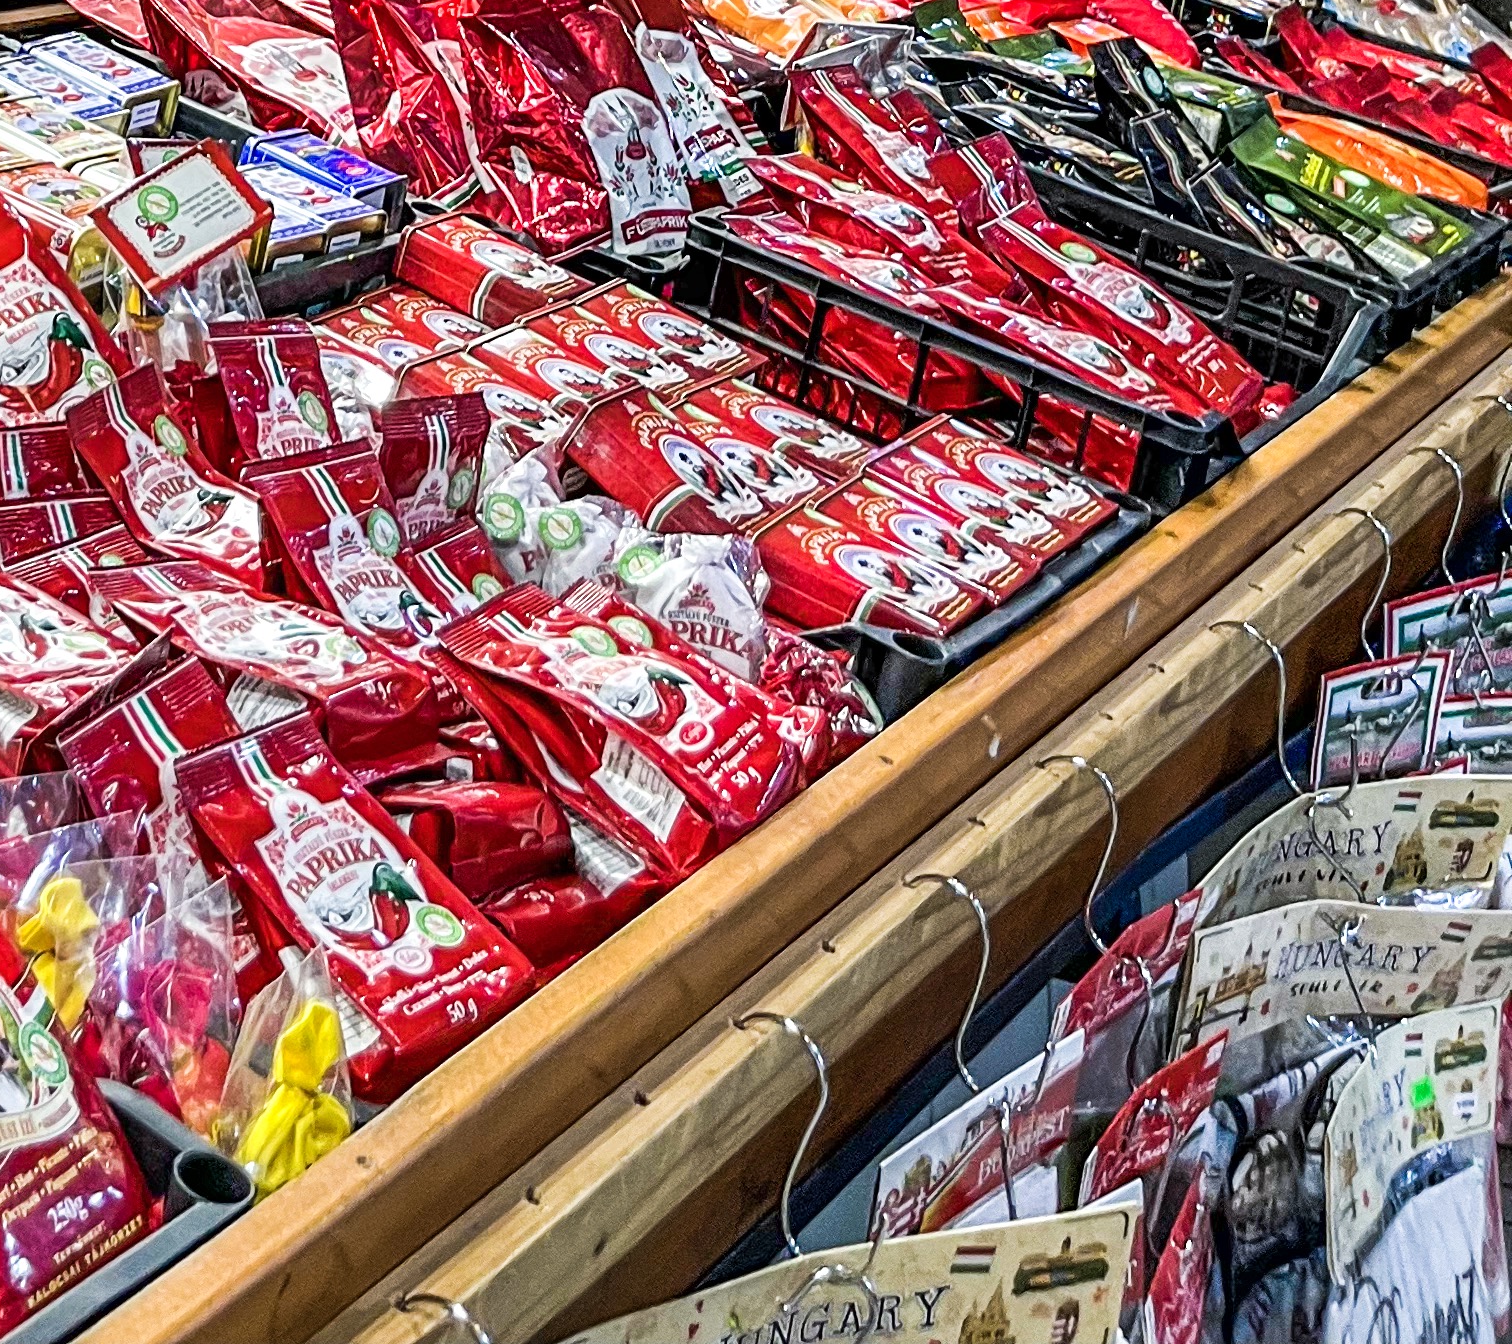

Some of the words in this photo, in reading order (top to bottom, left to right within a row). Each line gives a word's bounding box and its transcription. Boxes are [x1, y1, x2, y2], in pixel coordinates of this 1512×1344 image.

[140, 474, 201, 520] PAPRIKA
[334, 568, 409, 604] PAPRIKA
[287, 836, 387, 903] PAPRIKA
[1275, 940, 1436, 980] HUNGARY
[445, 999, 466, 1023] 50
[466, 997, 479, 1021] g
[47, 1194, 90, 1234] 250g
[26, 1262, 81, 1309] KALOCSAI
